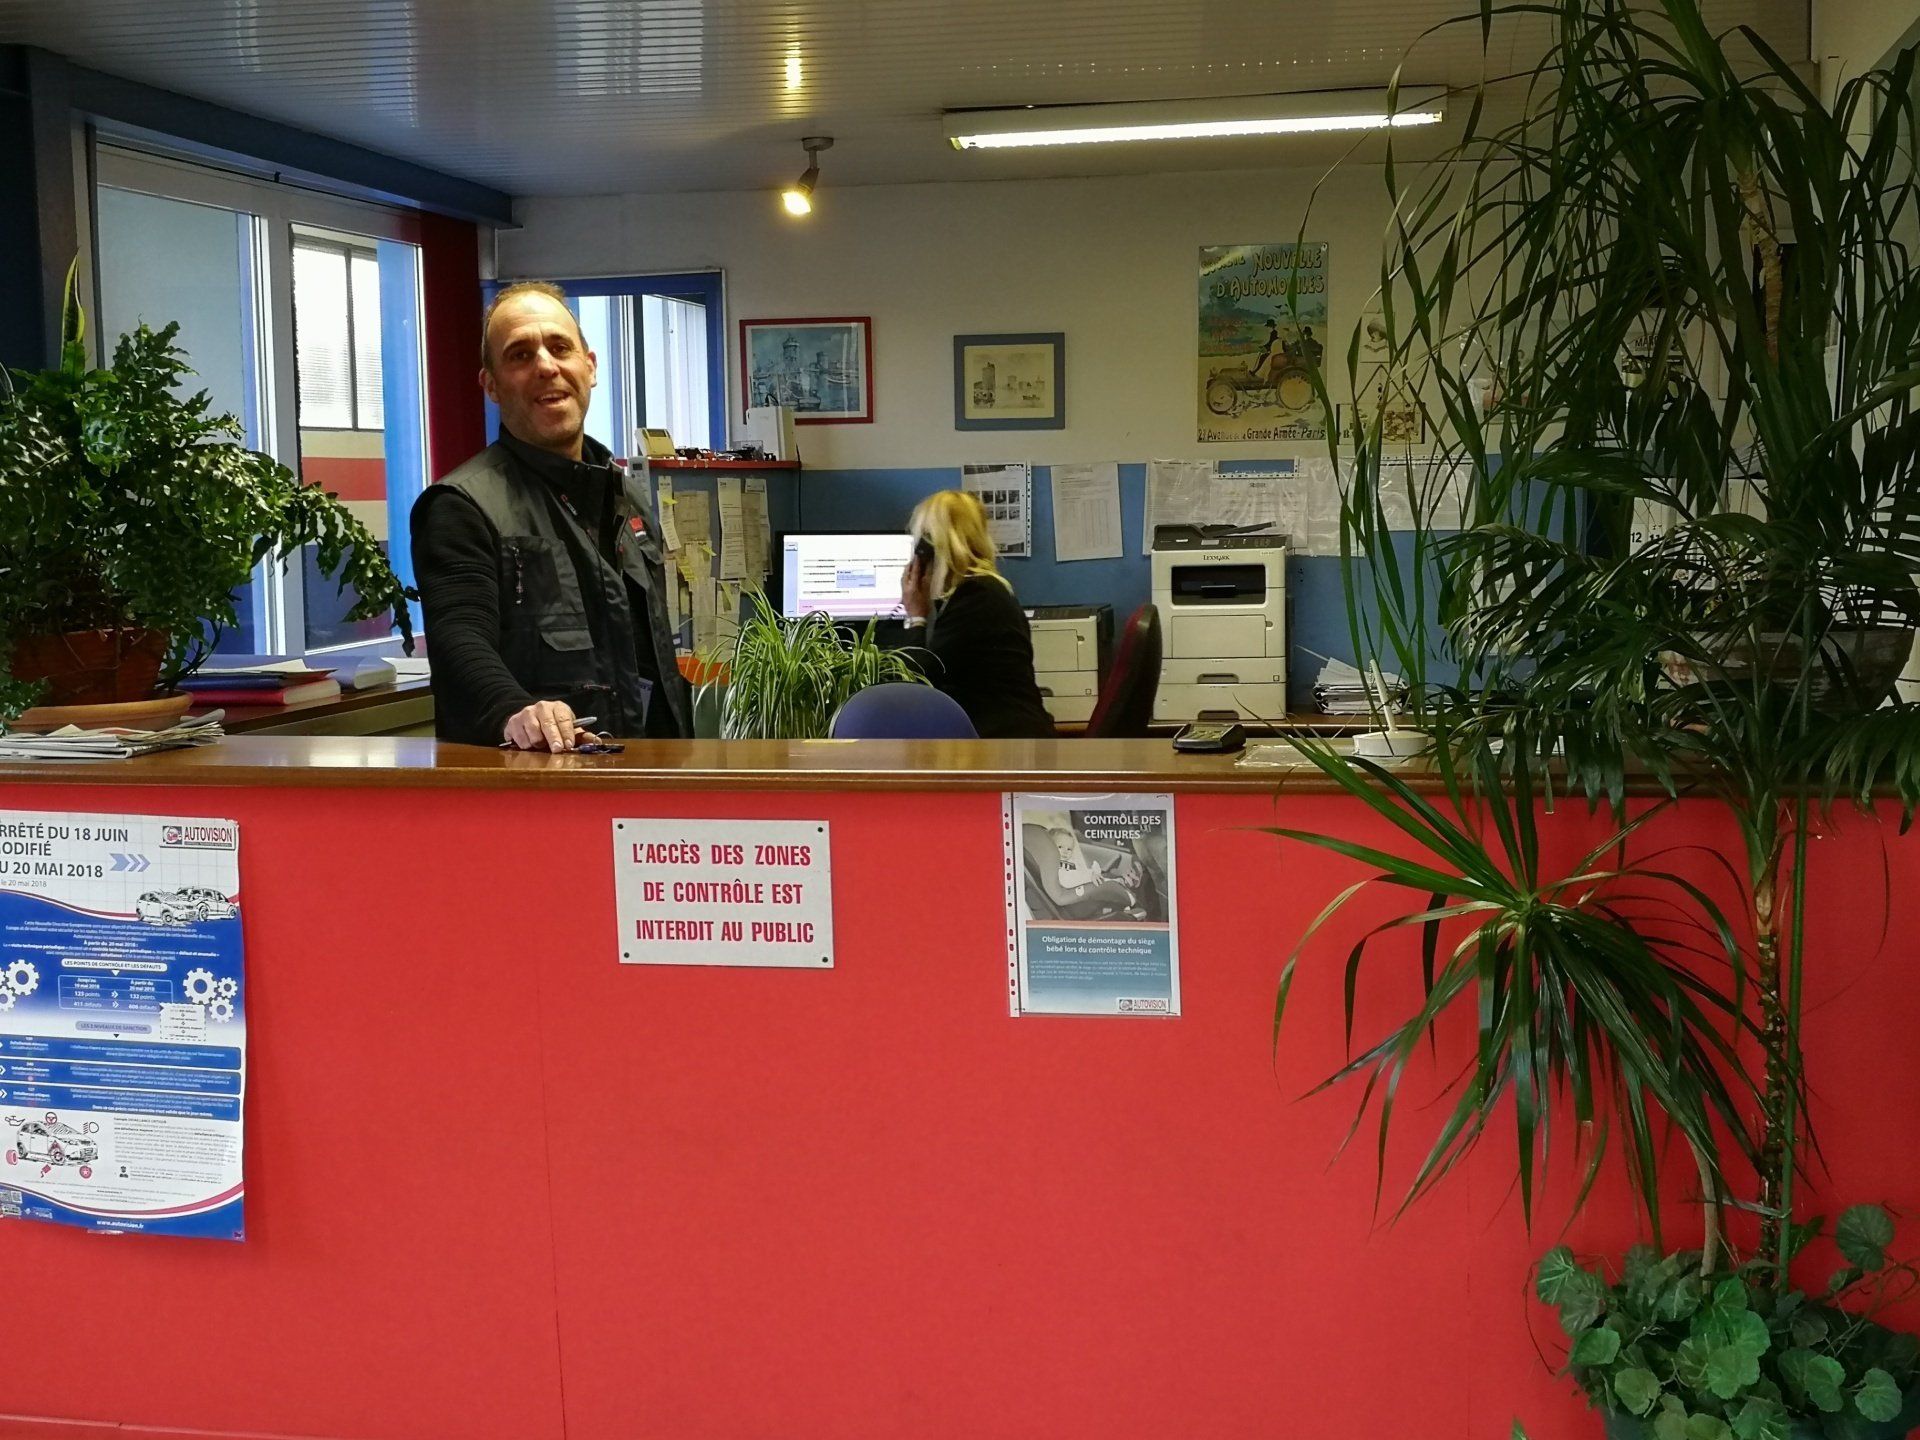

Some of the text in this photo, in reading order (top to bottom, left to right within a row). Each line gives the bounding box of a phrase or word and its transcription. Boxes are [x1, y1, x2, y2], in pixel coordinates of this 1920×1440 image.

[1252, 247, 1321, 277] NOUVLLE
[1216, 275, 1325, 301] D'AUTOMOILES
[1246, 427, 1272, 440] Grande
[1273, 427, 1296, 440] Armée
[1300, 427, 1327, 440] Paris
[1631, 532, 1642, 543] 12
[1084, 813, 1161, 825] CONTRÔLE DES
[48, 826, 70, 840] DU
[74, 827, 91, 841] 18
[94, 828, 128, 842] JUIN
[184, 826, 233, 843] AUTOVISION
[1084, 829, 1141, 840] CEINTURES
[0, 840, 52, 856] ODIFIÉ
[632, 838, 811, 867] L'ACCÈS DES ZONES
[13, 861, 31, 875] 20
[34, 862, 63, 876] MAI
[67, 863, 103, 878] 2018
[31, 880, 47, 888] 2018
[643, 878, 803, 905] DE CONTRÔLE EST
[636, 919, 814, 943] INTERDIT AU PUBLIC
[1042, 936, 1155, 946] Obligation de démontage du siège
[1046, 945, 1152, 955] bébé lors du contrôle technique
[1133, 999, 1167, 1010] AUTOVISION
